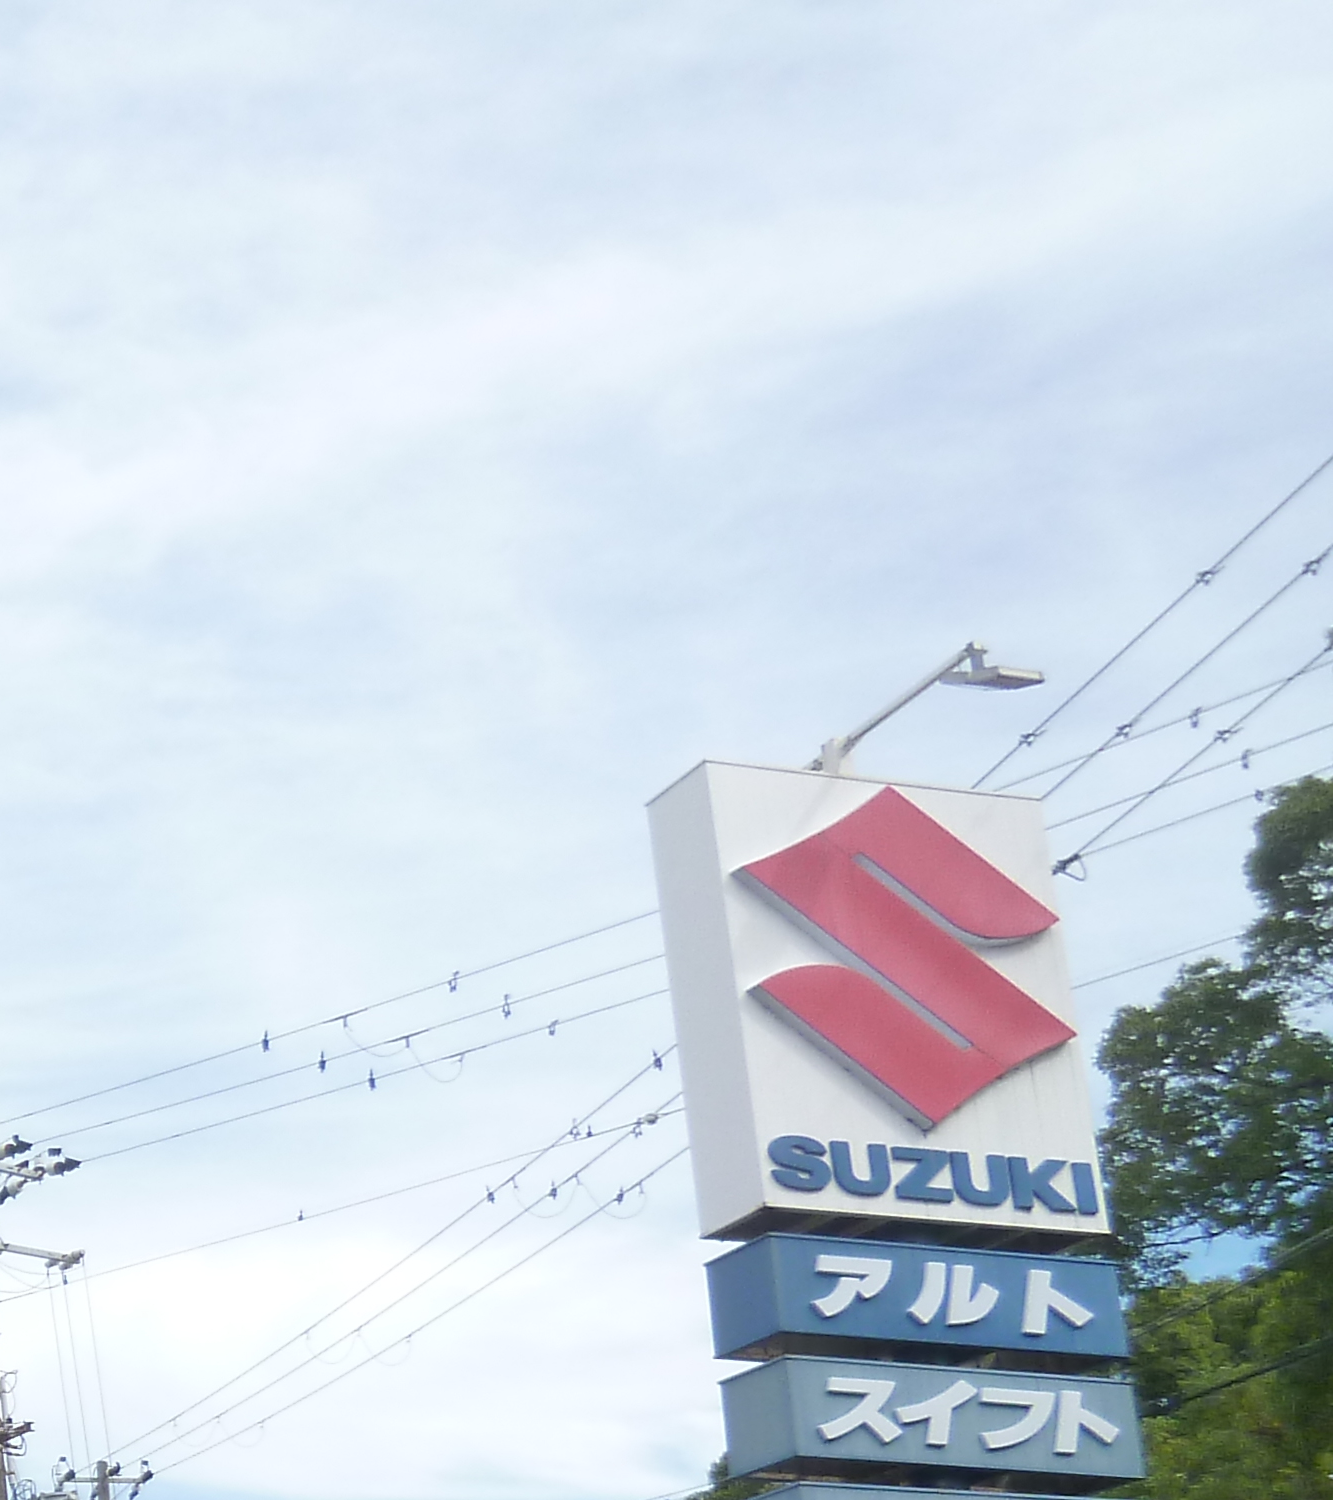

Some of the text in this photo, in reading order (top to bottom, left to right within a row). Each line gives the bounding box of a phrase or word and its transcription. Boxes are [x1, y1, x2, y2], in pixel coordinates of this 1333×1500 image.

[767, 1134, 1098, 1215] SUZUKI
[811, 1254, 1094, 1336] アルト
[818, 1377, 1120, 1455] スイフト
